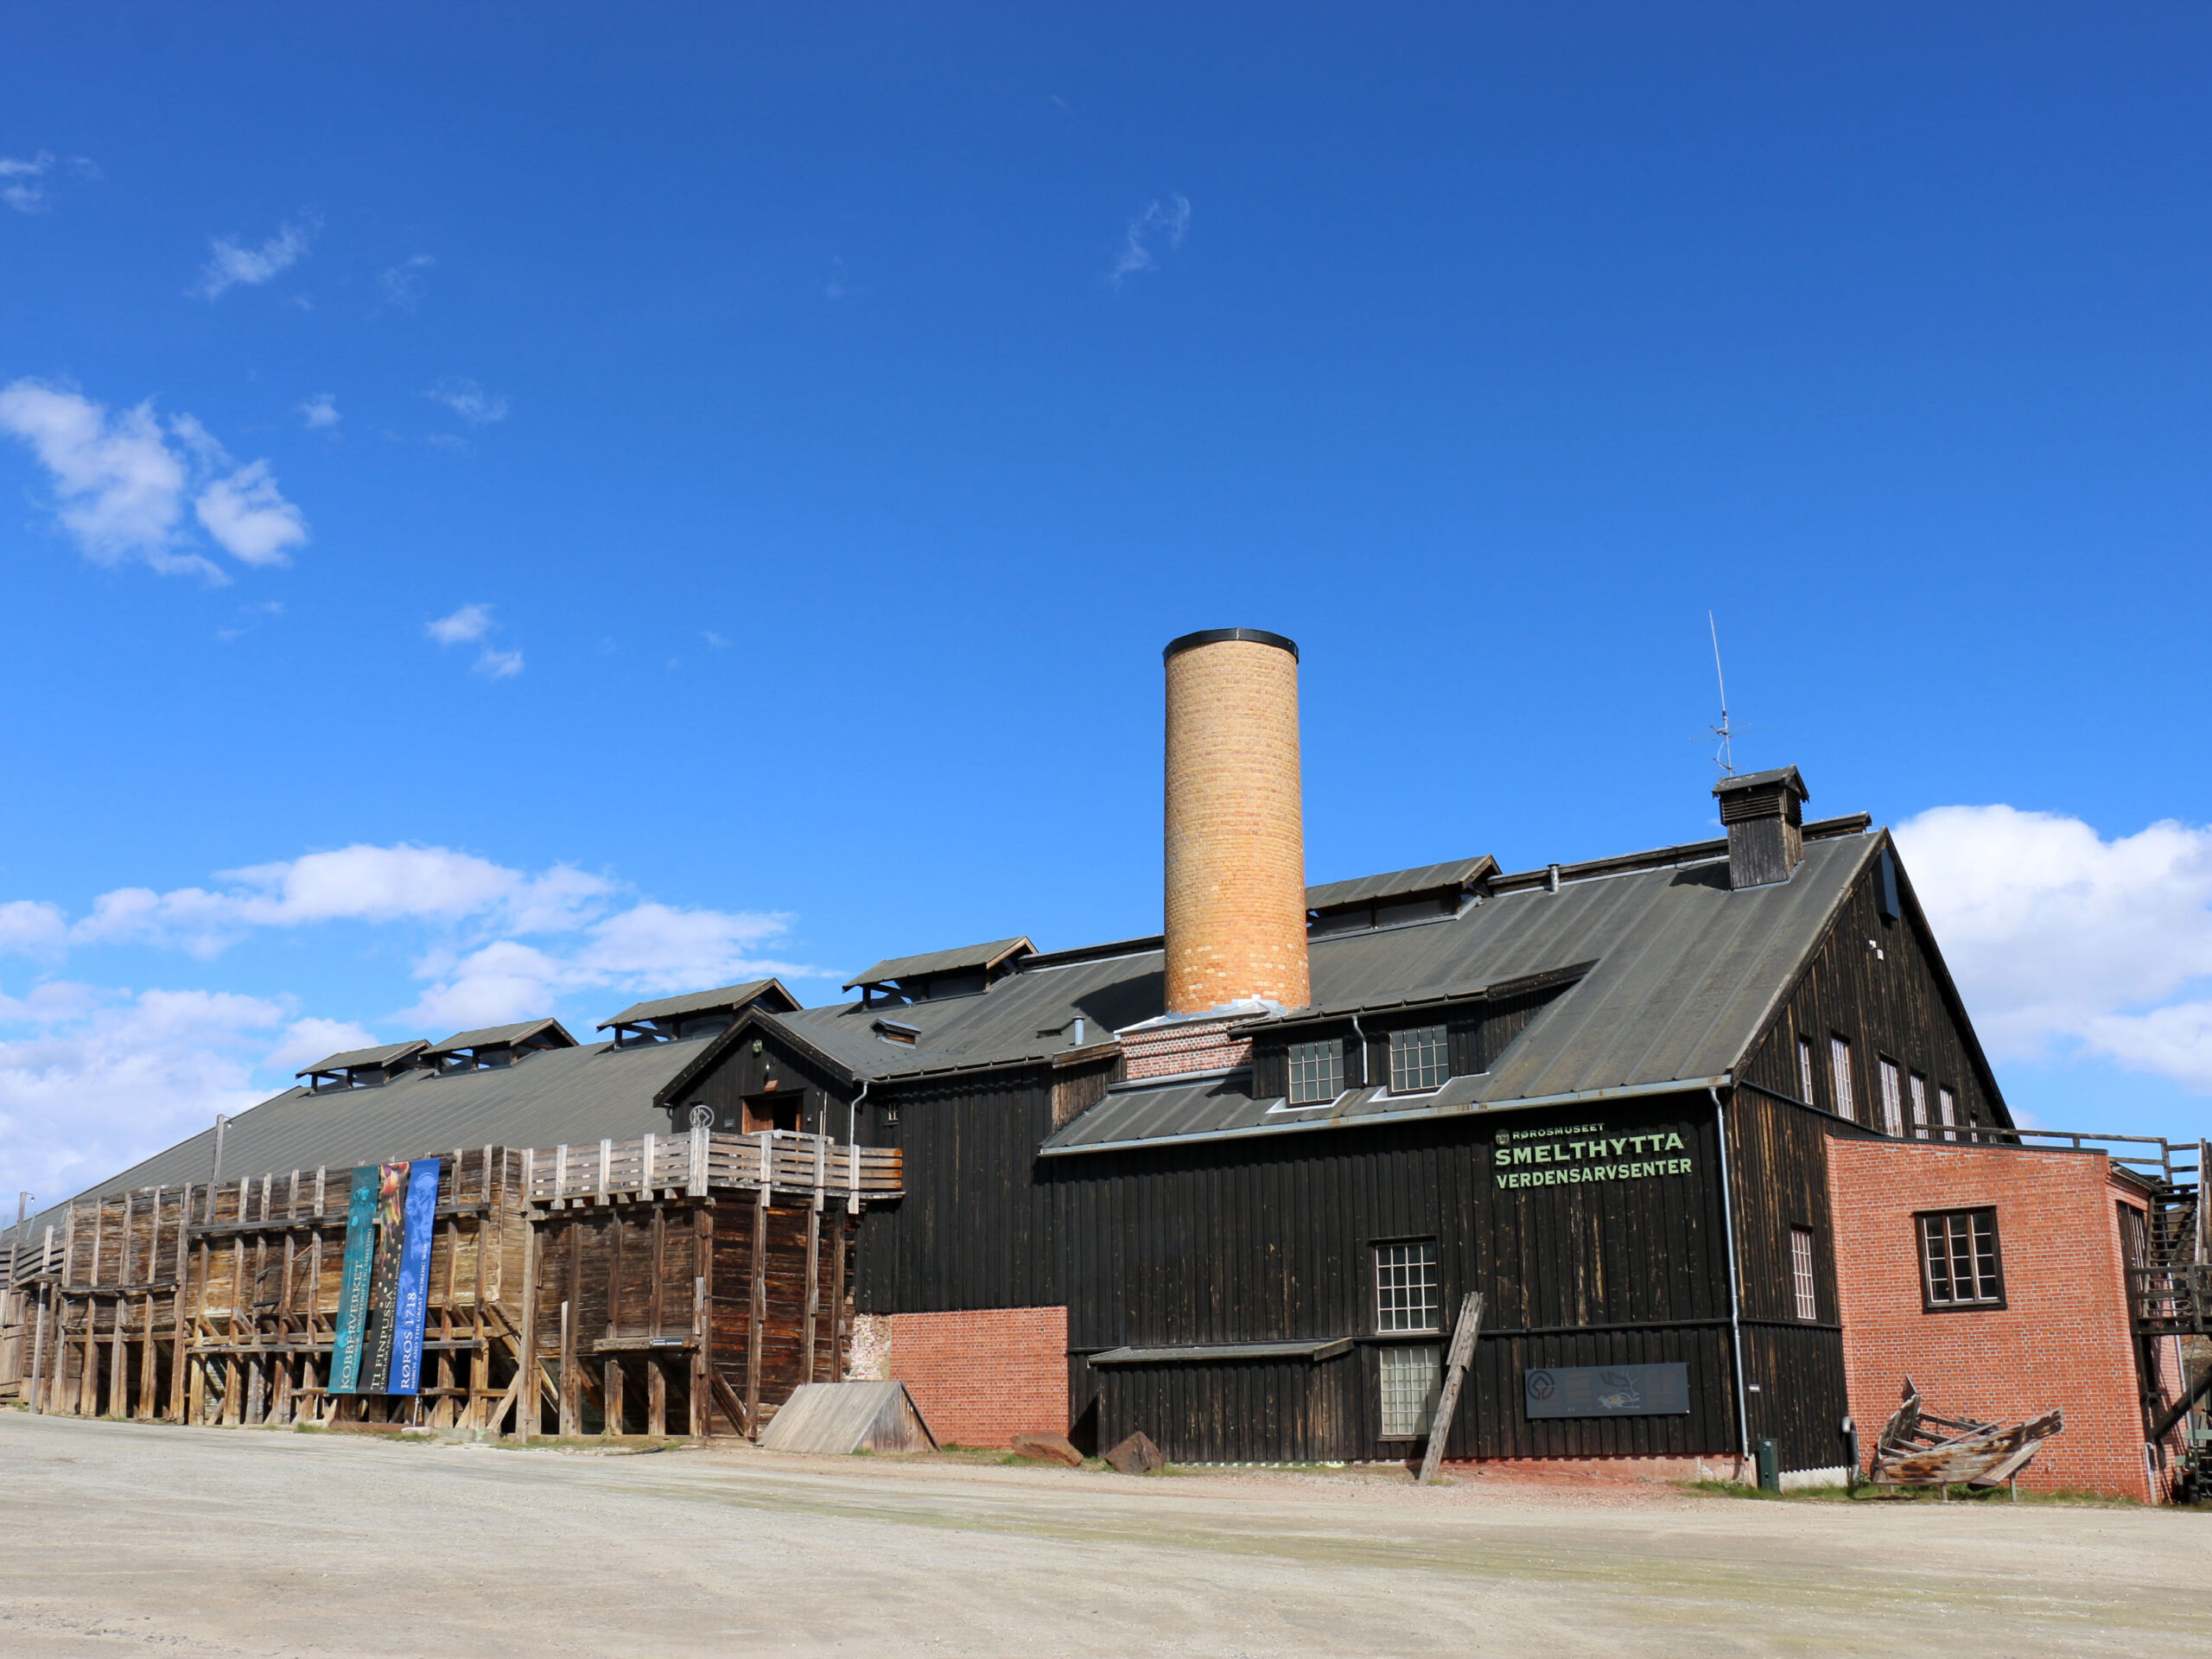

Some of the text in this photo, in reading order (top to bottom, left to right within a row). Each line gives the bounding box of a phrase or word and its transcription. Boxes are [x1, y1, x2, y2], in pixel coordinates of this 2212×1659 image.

[1495, 1133, 1685, 1166] SMELTHYTTA
[1513, 1123, 1605, 1139] RØROSMUSEET
[1497, 1158, 1692, 1189] VERDENSARVSENTER
[340, 1261, 363, 1389] KOBBERVERKET
[370, 1290, 393, 1389] TI FINPUSSA
[401, 1293, 416, 1389] RØROS 1718
